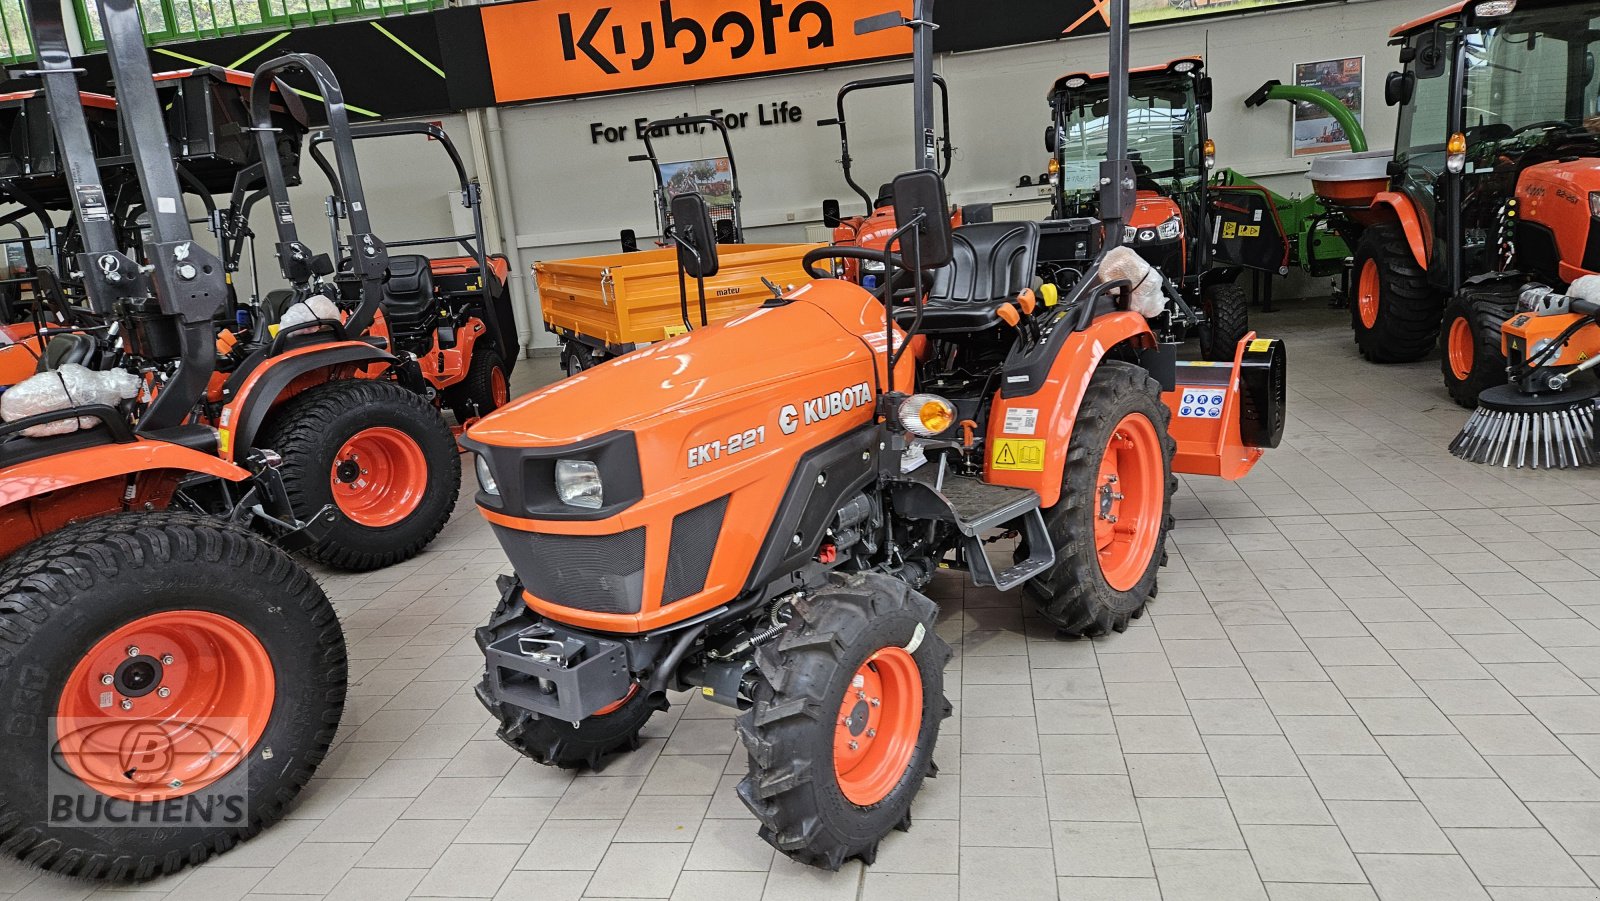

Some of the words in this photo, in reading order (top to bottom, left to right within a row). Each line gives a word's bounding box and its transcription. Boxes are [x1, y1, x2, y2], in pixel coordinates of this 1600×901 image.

[558, 0, 834, 75] Kubota
[590, 122, 627, 144] For
[634, 112, 705, 139] Earth,
[710, 108, 748, 131] For
[758, 100, 802, 126] Life
[716, 287, 740, 297] mateu
[803, 381, 873, 426] KUBOTA
[687, 425, 765, 468] EK1-221
